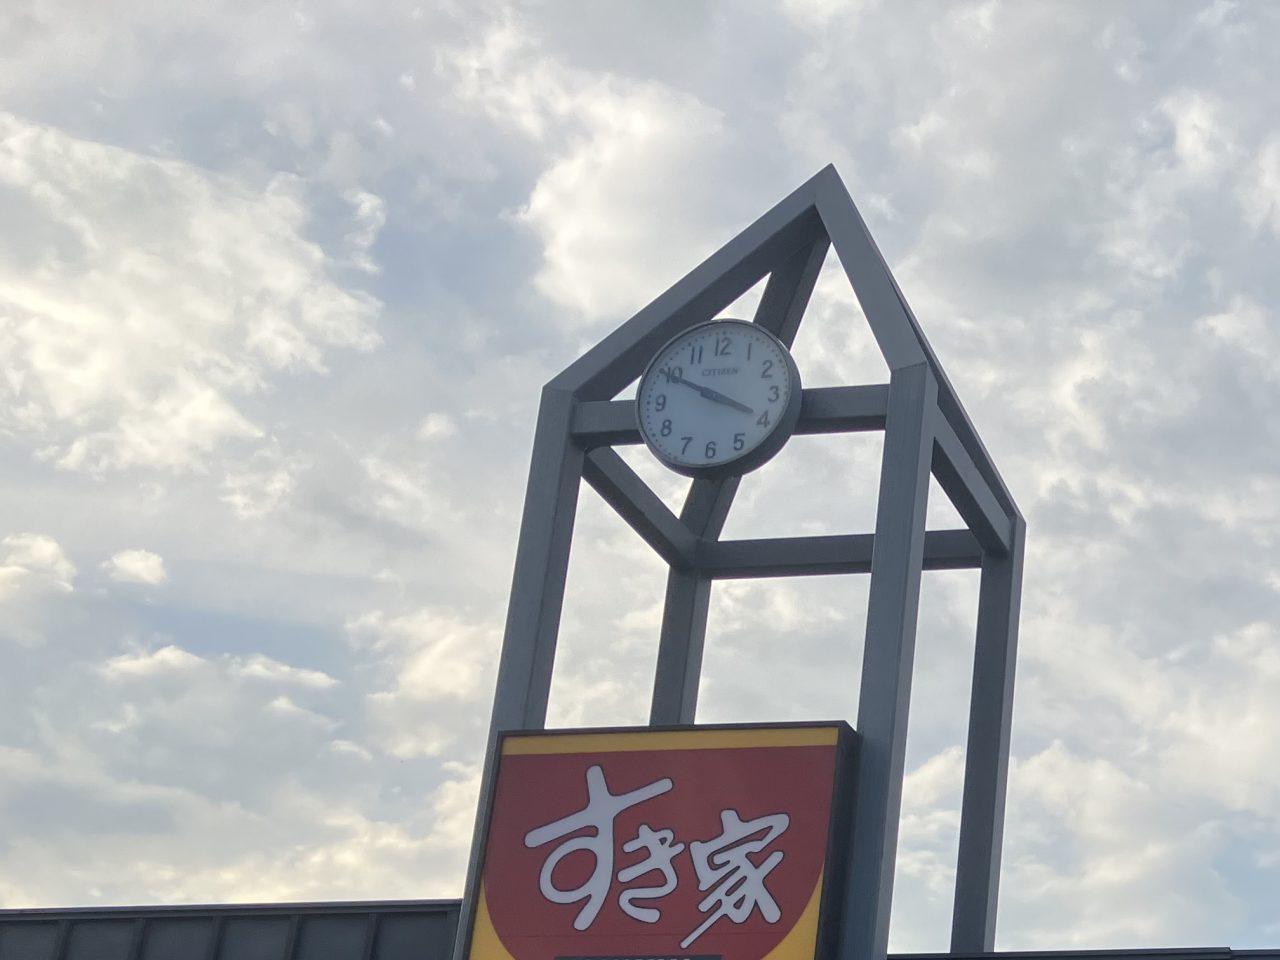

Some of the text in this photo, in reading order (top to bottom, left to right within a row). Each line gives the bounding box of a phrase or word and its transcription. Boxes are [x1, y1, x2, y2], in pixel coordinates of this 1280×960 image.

[689, 346, 703, 364] 11
[714, 337, 732, 357] 12
[746, 342, 752, 361] 1
[664, 366, 683, 384] 10
[702, 367, 739, 377] CITIZEN
[761, 360, 773, 379] 2
[768, 385, 780, 403] 3
[654, 395, 667, 412] 9
[660, 419, 672, 437] 8
[756, 411, 770, 428] 4
[681, 436, 693, 455] 7
[704, 441, 717, 459] 6
[733, 432, 746, 451] 5
[524, 765, 791, 949] すき家
